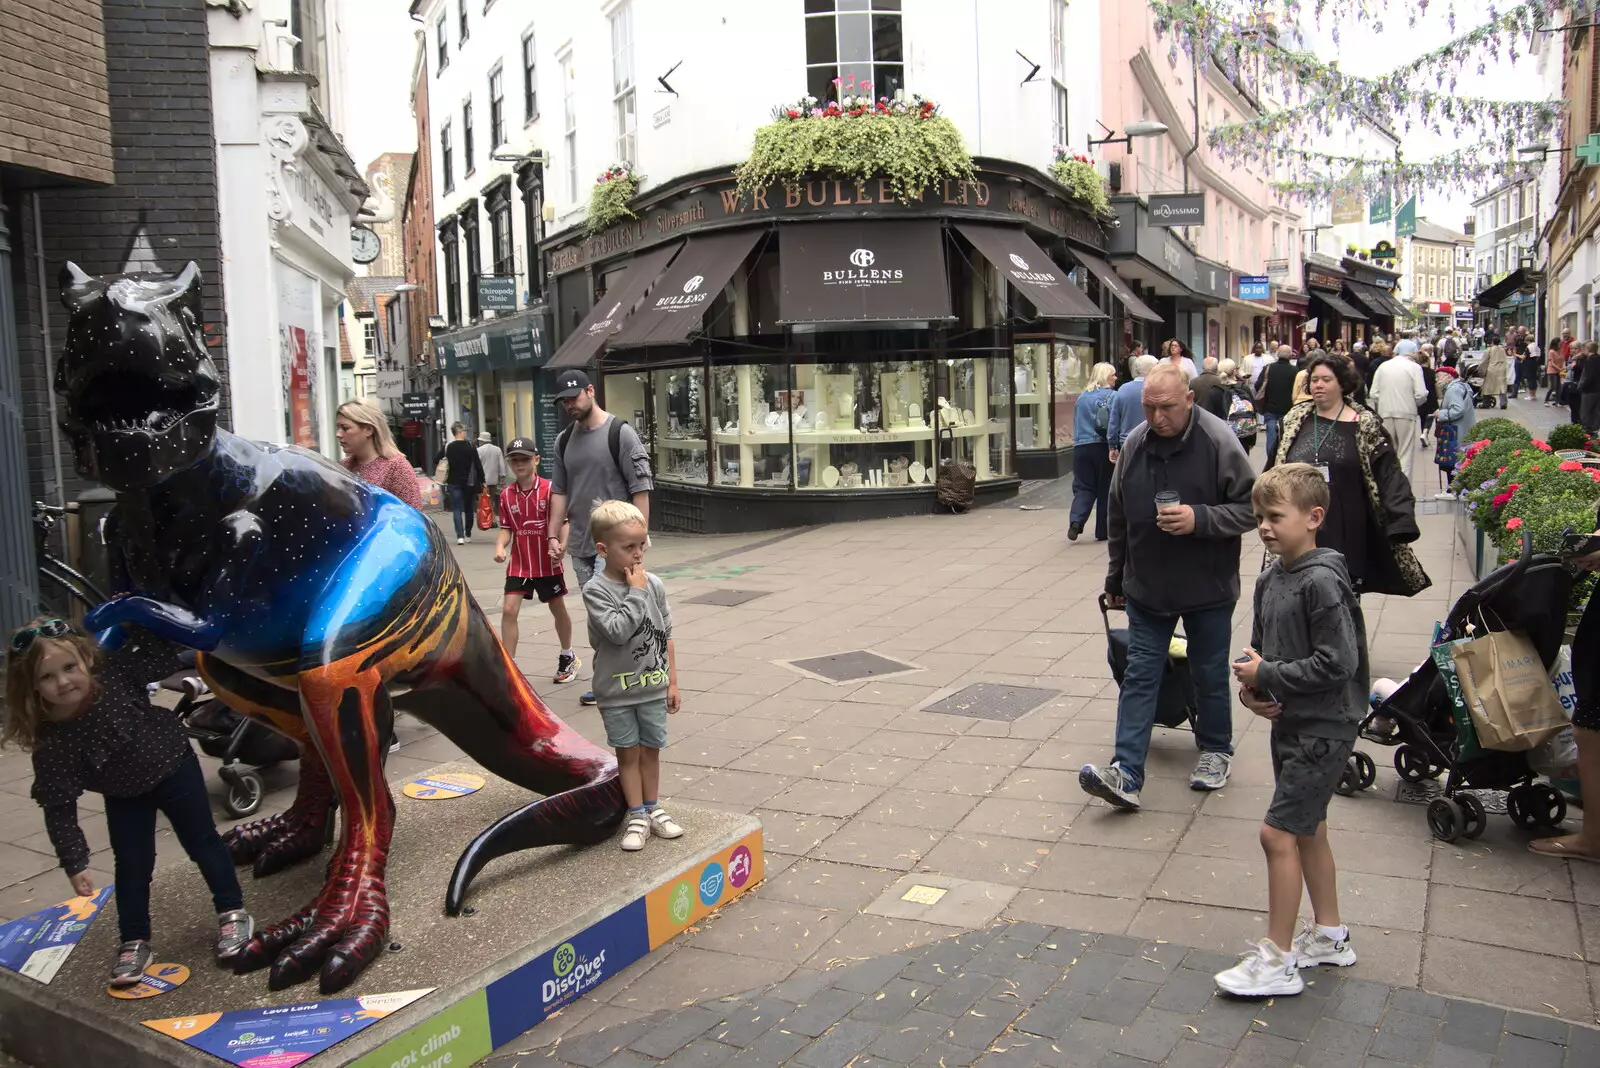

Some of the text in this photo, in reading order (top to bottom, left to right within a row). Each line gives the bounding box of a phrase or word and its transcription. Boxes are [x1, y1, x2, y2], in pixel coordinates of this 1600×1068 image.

[942, 179, 990, 206] LTD
[657, 201, 705, 233] Silversmith
[1153, 204, 1199, 217] BRAVISSIMO
[823, 269, 904, 281] BULLENS
[1010, 270, 1056, 282] BULLENS
[1240, 285, 1265, 294] to let
[656, 292, 708, 306] BULLENS
[612, 665, 669, 690] T-rex
[142, 974, 168, 989] UTION
[543, 948, 606, 1003] Discover
[291, 1003, 318, 1012] Land
[171, 1019, 197, 1031] 13
[227, 1034, 276, 1047] Discover
[420, 1024, 462, 1057] climb
